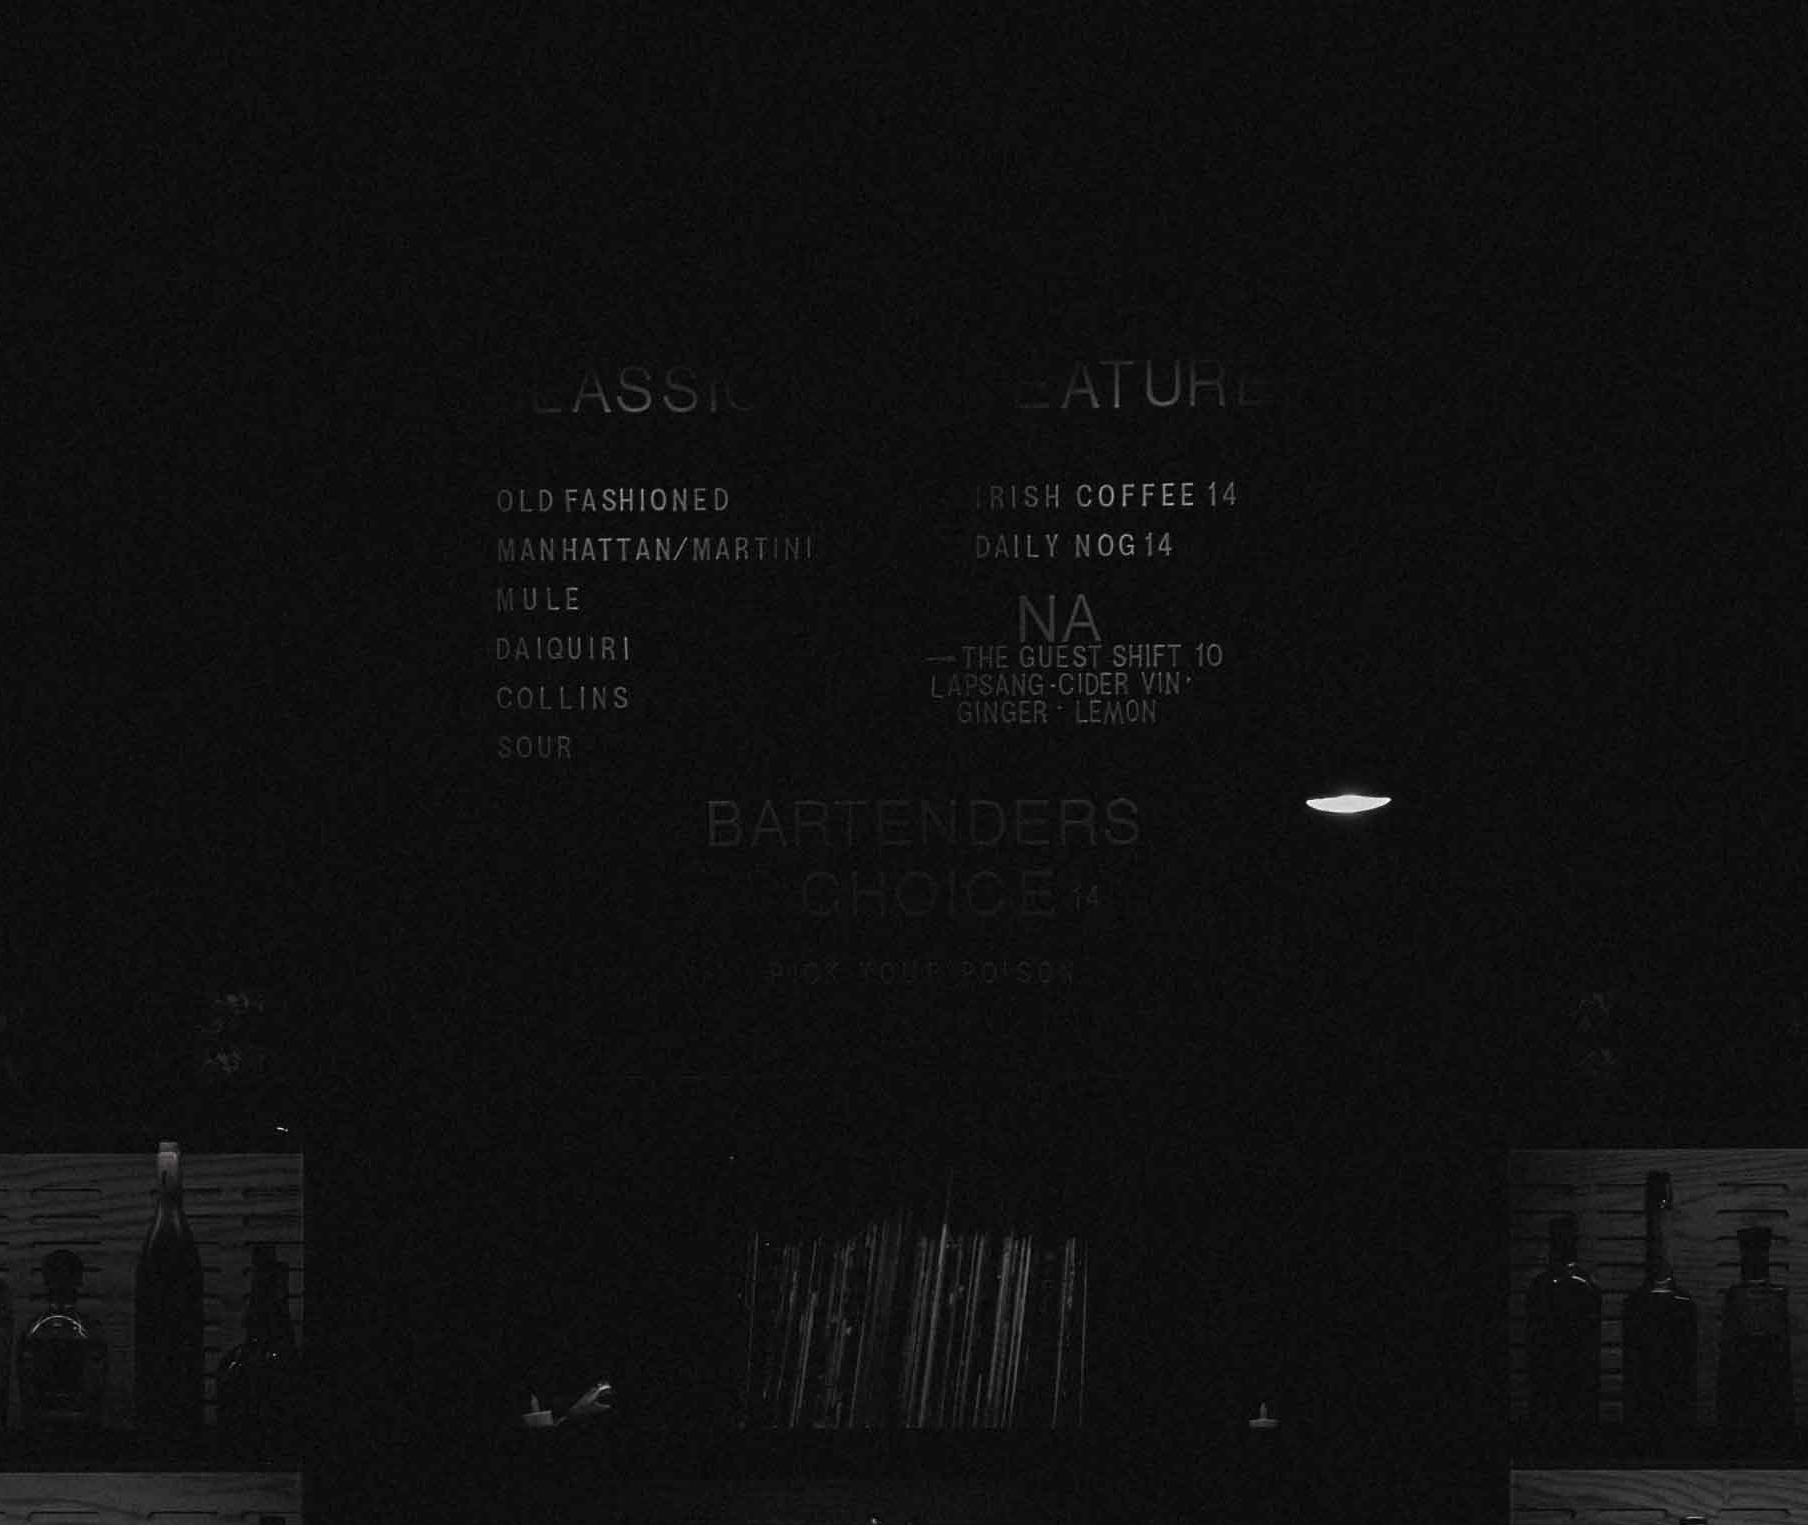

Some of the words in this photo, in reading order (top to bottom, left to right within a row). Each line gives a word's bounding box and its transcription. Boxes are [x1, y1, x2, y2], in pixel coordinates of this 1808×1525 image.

[496, 488, 554, 513] OLD
[564, 487, 730, 513] FASHIONED
[975, 483, 1061, 509] IRISH
[1075, 481, 1195, 509] COFFEE
[1208, 480, 1238, 507] 14
[497, 536, 812, 562] MANHATTAN/MARTINI
[975, 533, 1059, 559] DAILY
[1074, 532, 1136, 558] NOG
[1144, 531, 1174, 557] 14
[496, 586, 581, 612] MULE
[1018, 593, 1102, 643] NA
[496, 635, 630, 661] DAIQUIRI
[1018, 644, 1104, 669] GUEST
[1112, 643, 1182, 668] SHIFT
[1195, 642, 1224, 667] 10
[496, 685, 629, 711] COLLINS
[957, 700, 1049, 725] GINGER
[1075, 699, 1157, 725] LEMON
[497, 735, 573, 760] SOUR
[706, 796, 1140, 848] BARTENDERS
[801, 870, 1056, 917] CHOICE
